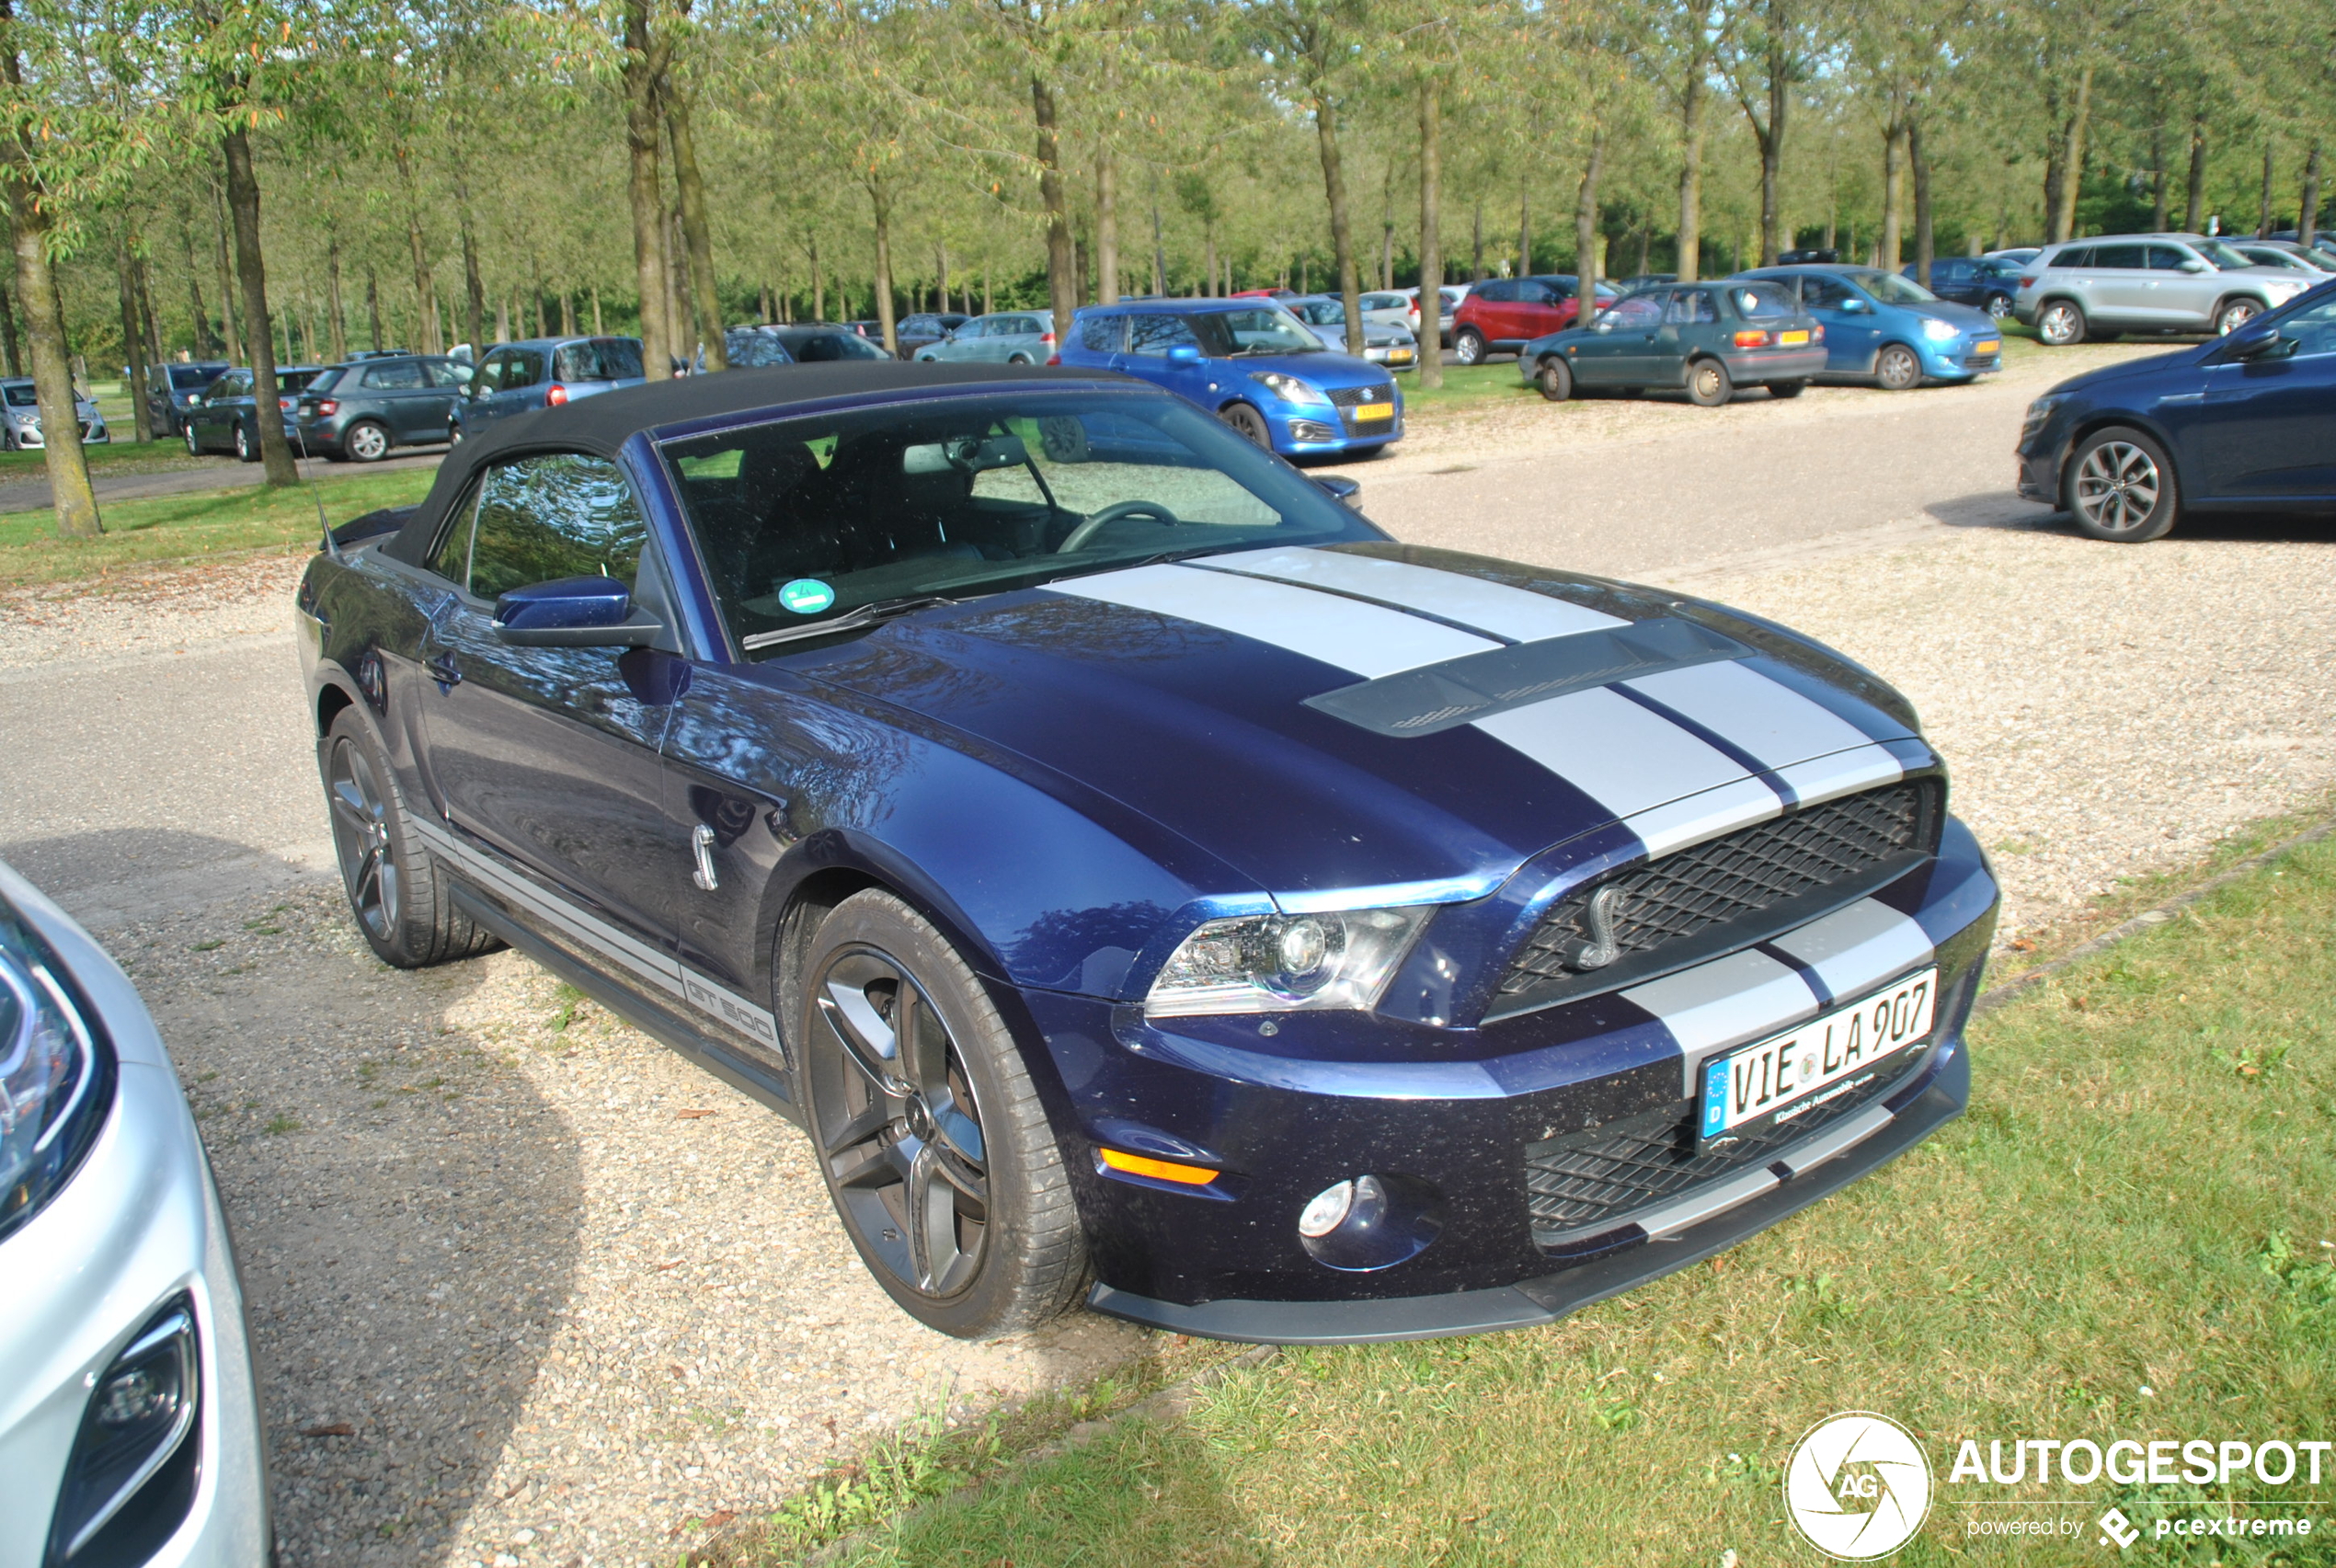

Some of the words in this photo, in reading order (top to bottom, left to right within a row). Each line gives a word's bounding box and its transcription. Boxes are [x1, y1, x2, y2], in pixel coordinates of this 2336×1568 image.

[1735, 1040, 1797, 1115] VIE
[1824, 1013, 1861, 1075] LA
[1873, 980, 1929, 1053] 907
[1813, 1079, 1854, 1107] Automobile
[1710, 1105, 1720, 1123] D
